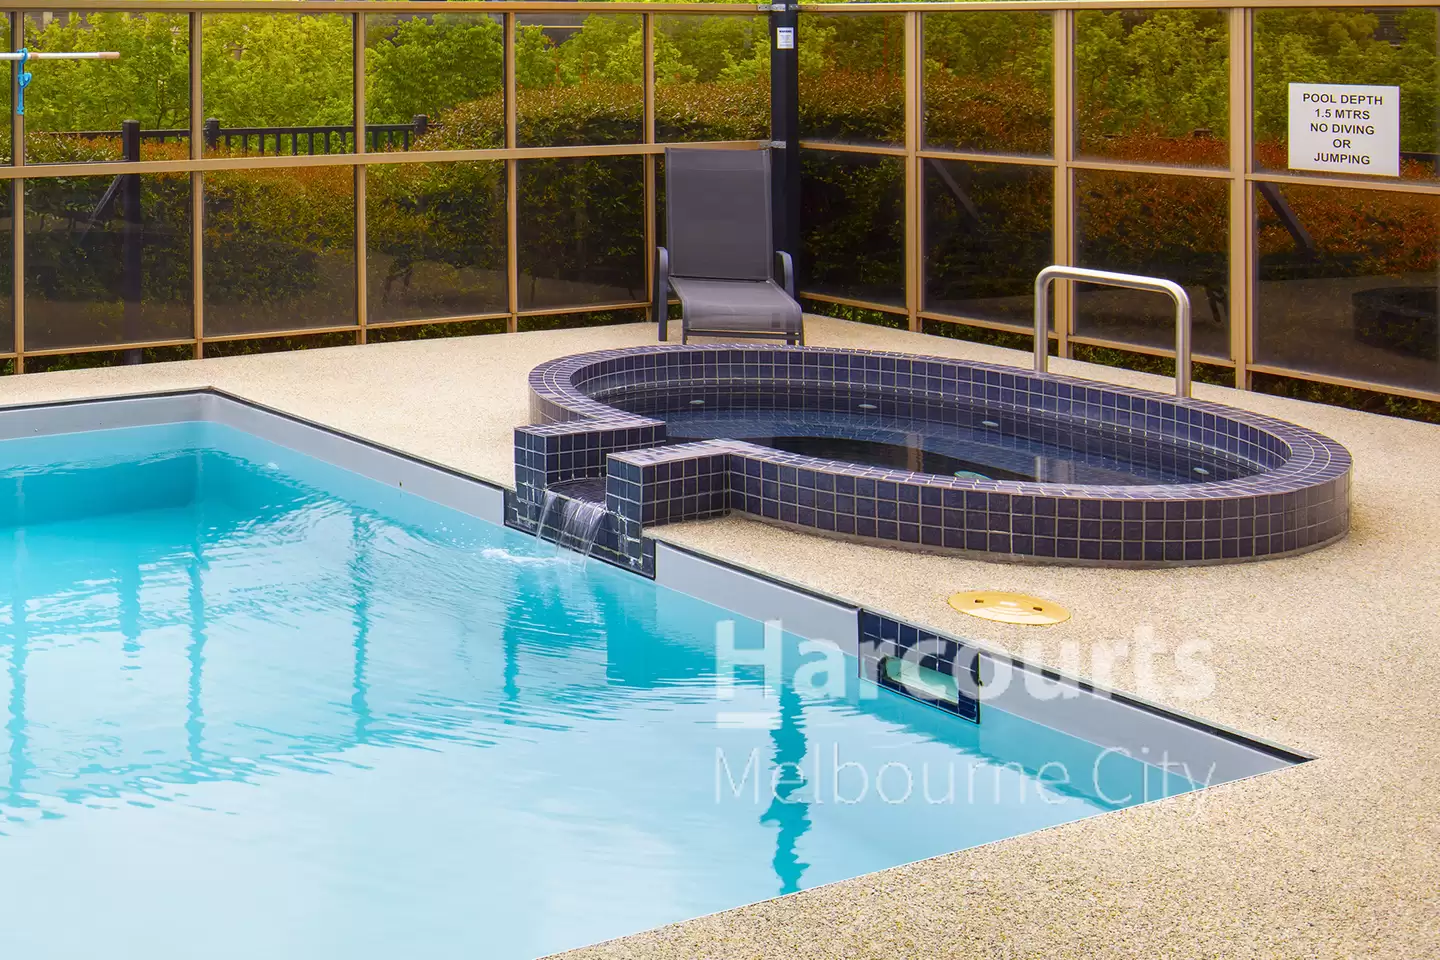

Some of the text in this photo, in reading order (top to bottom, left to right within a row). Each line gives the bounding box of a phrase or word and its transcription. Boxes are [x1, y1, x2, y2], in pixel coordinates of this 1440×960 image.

[1302, 93, 1383, 106] POOL DEPTH
[1315, 108, 1371, 120] 1.5 MTRS
[1310, 123, 1375, 135] NO DIVING
[1332, 138, 1351, 149] OR
[1314, 152, 1371, 165] JUMPING
